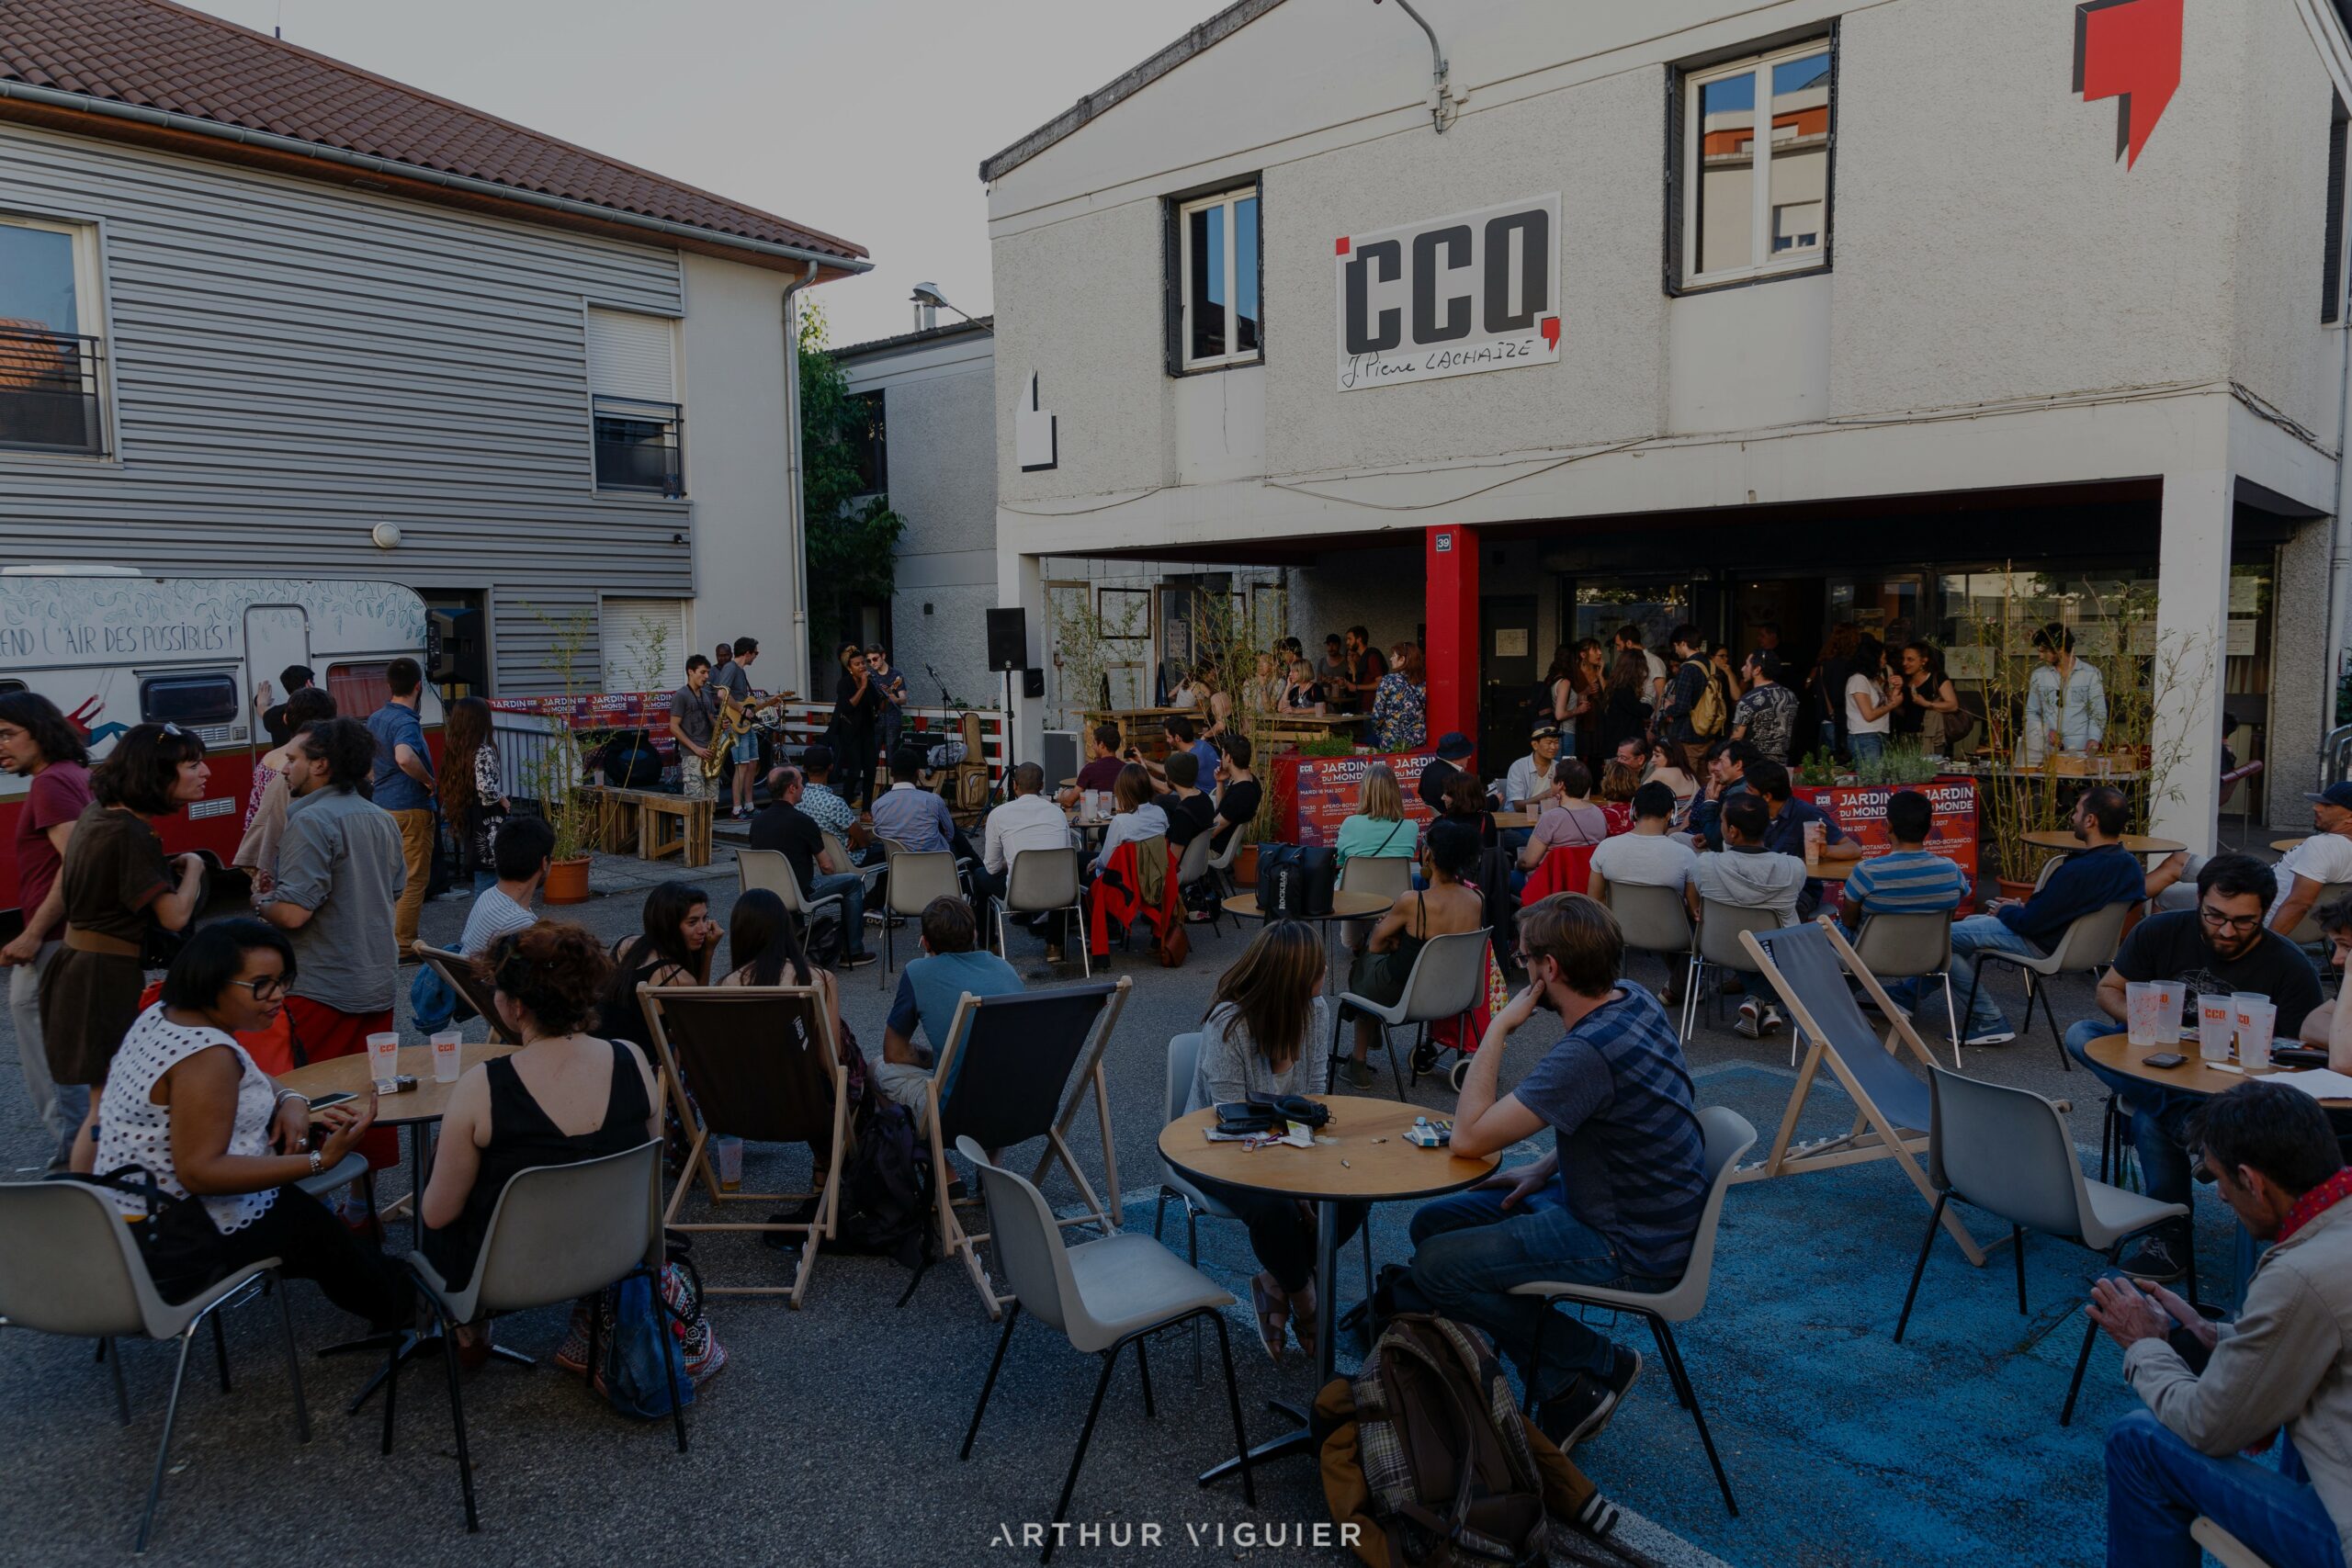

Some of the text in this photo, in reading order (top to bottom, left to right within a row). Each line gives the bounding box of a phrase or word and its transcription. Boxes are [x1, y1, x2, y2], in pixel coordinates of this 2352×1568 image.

[1346, 209, 1549, 355] CCO
[1438, 537, 1450, 547] 39
[0, 627, 35, 657] END
[104, 626, 137, 652] DES
[492, 700, 526, 708] JARDIN
[543, 697, 577, 706] JARDN
[592, 695, 628, 704] JARDIN
[1321, 761, 1368, 773] JARDIN
[1395, 757, 1436, 769] JARDI
[1333, 773, 1363, 782] MOND
[1925, 786, 1974, 800] JARDIN
[1839, 793, 1894, 807] JARDIN
[1935, 800, 1974, 812] MONDE
[1852, 807, 1888, 817] MOND
[1279, 871, 1287, 909] ROCKBAG
[2205, 1009, 2226, 1020] CCO
[437, 1043, 456, 1052] CCO
